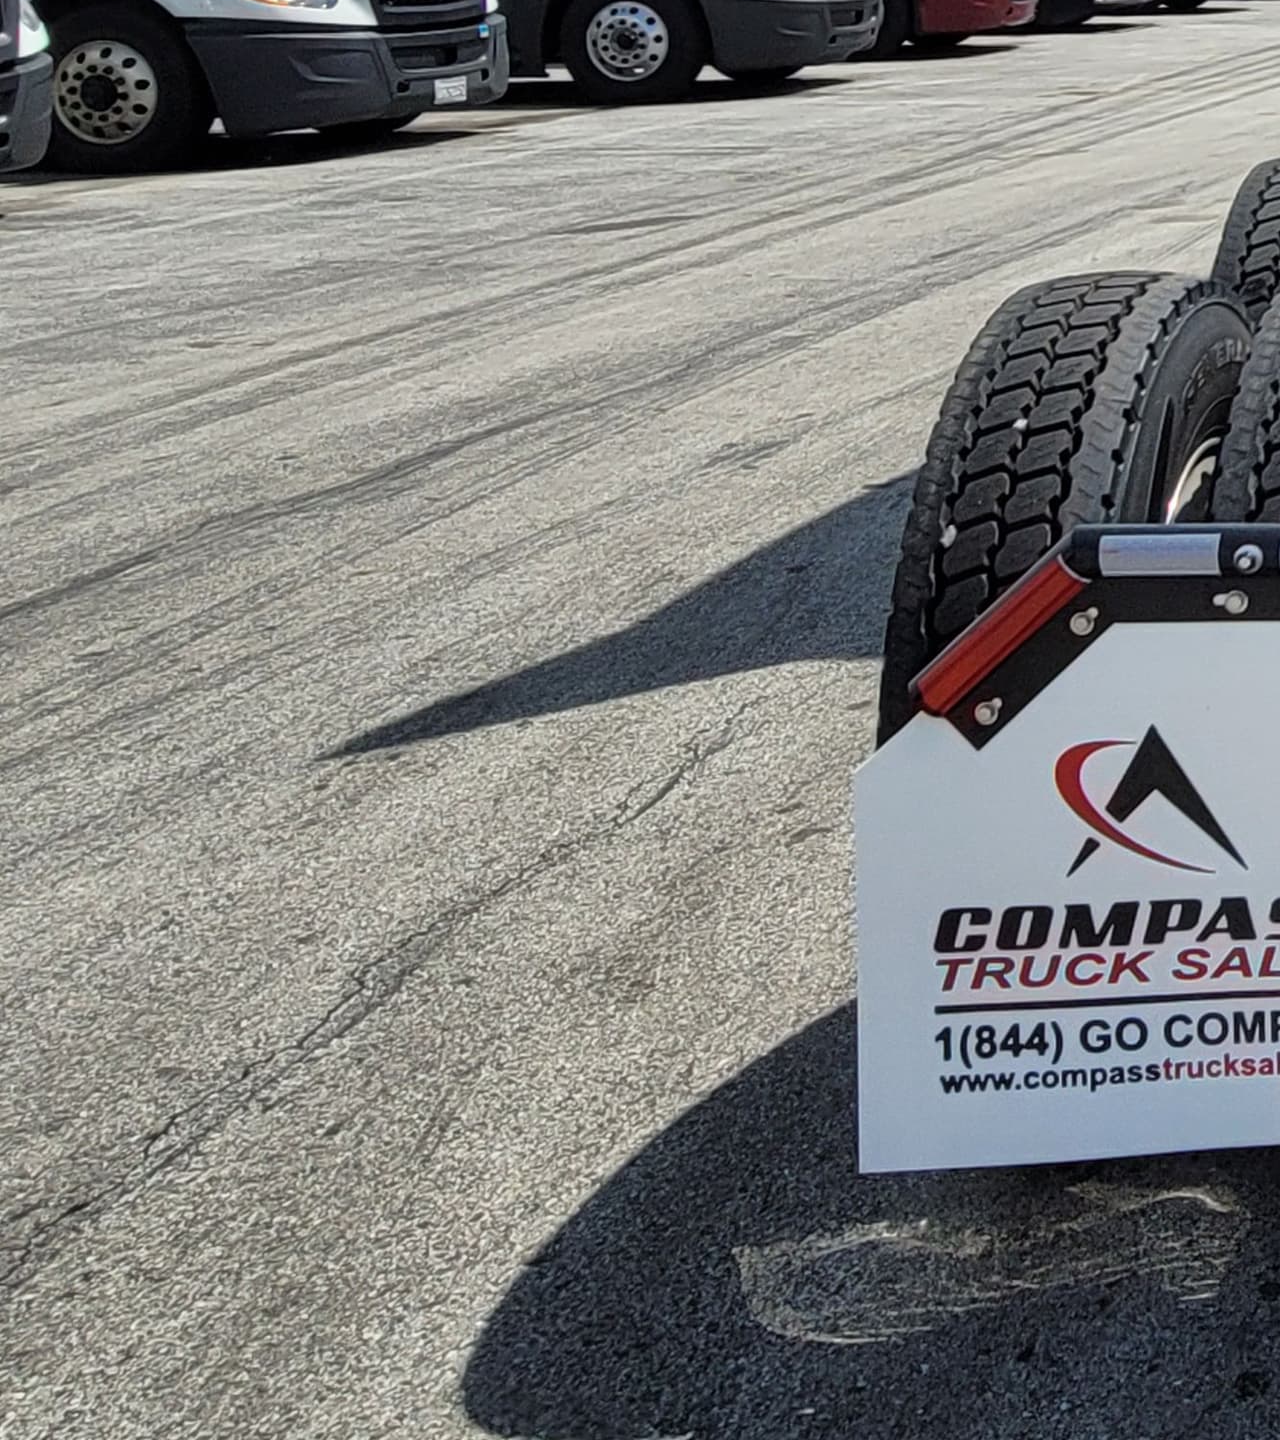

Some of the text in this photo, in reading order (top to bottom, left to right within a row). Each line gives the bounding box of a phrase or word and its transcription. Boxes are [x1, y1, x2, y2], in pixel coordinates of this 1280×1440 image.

[934, 950, 1155, 992] TRUCK
[934, 1021, 1064, 1069] 1(844)
[1079, 1016, 1149, 1053] GO
